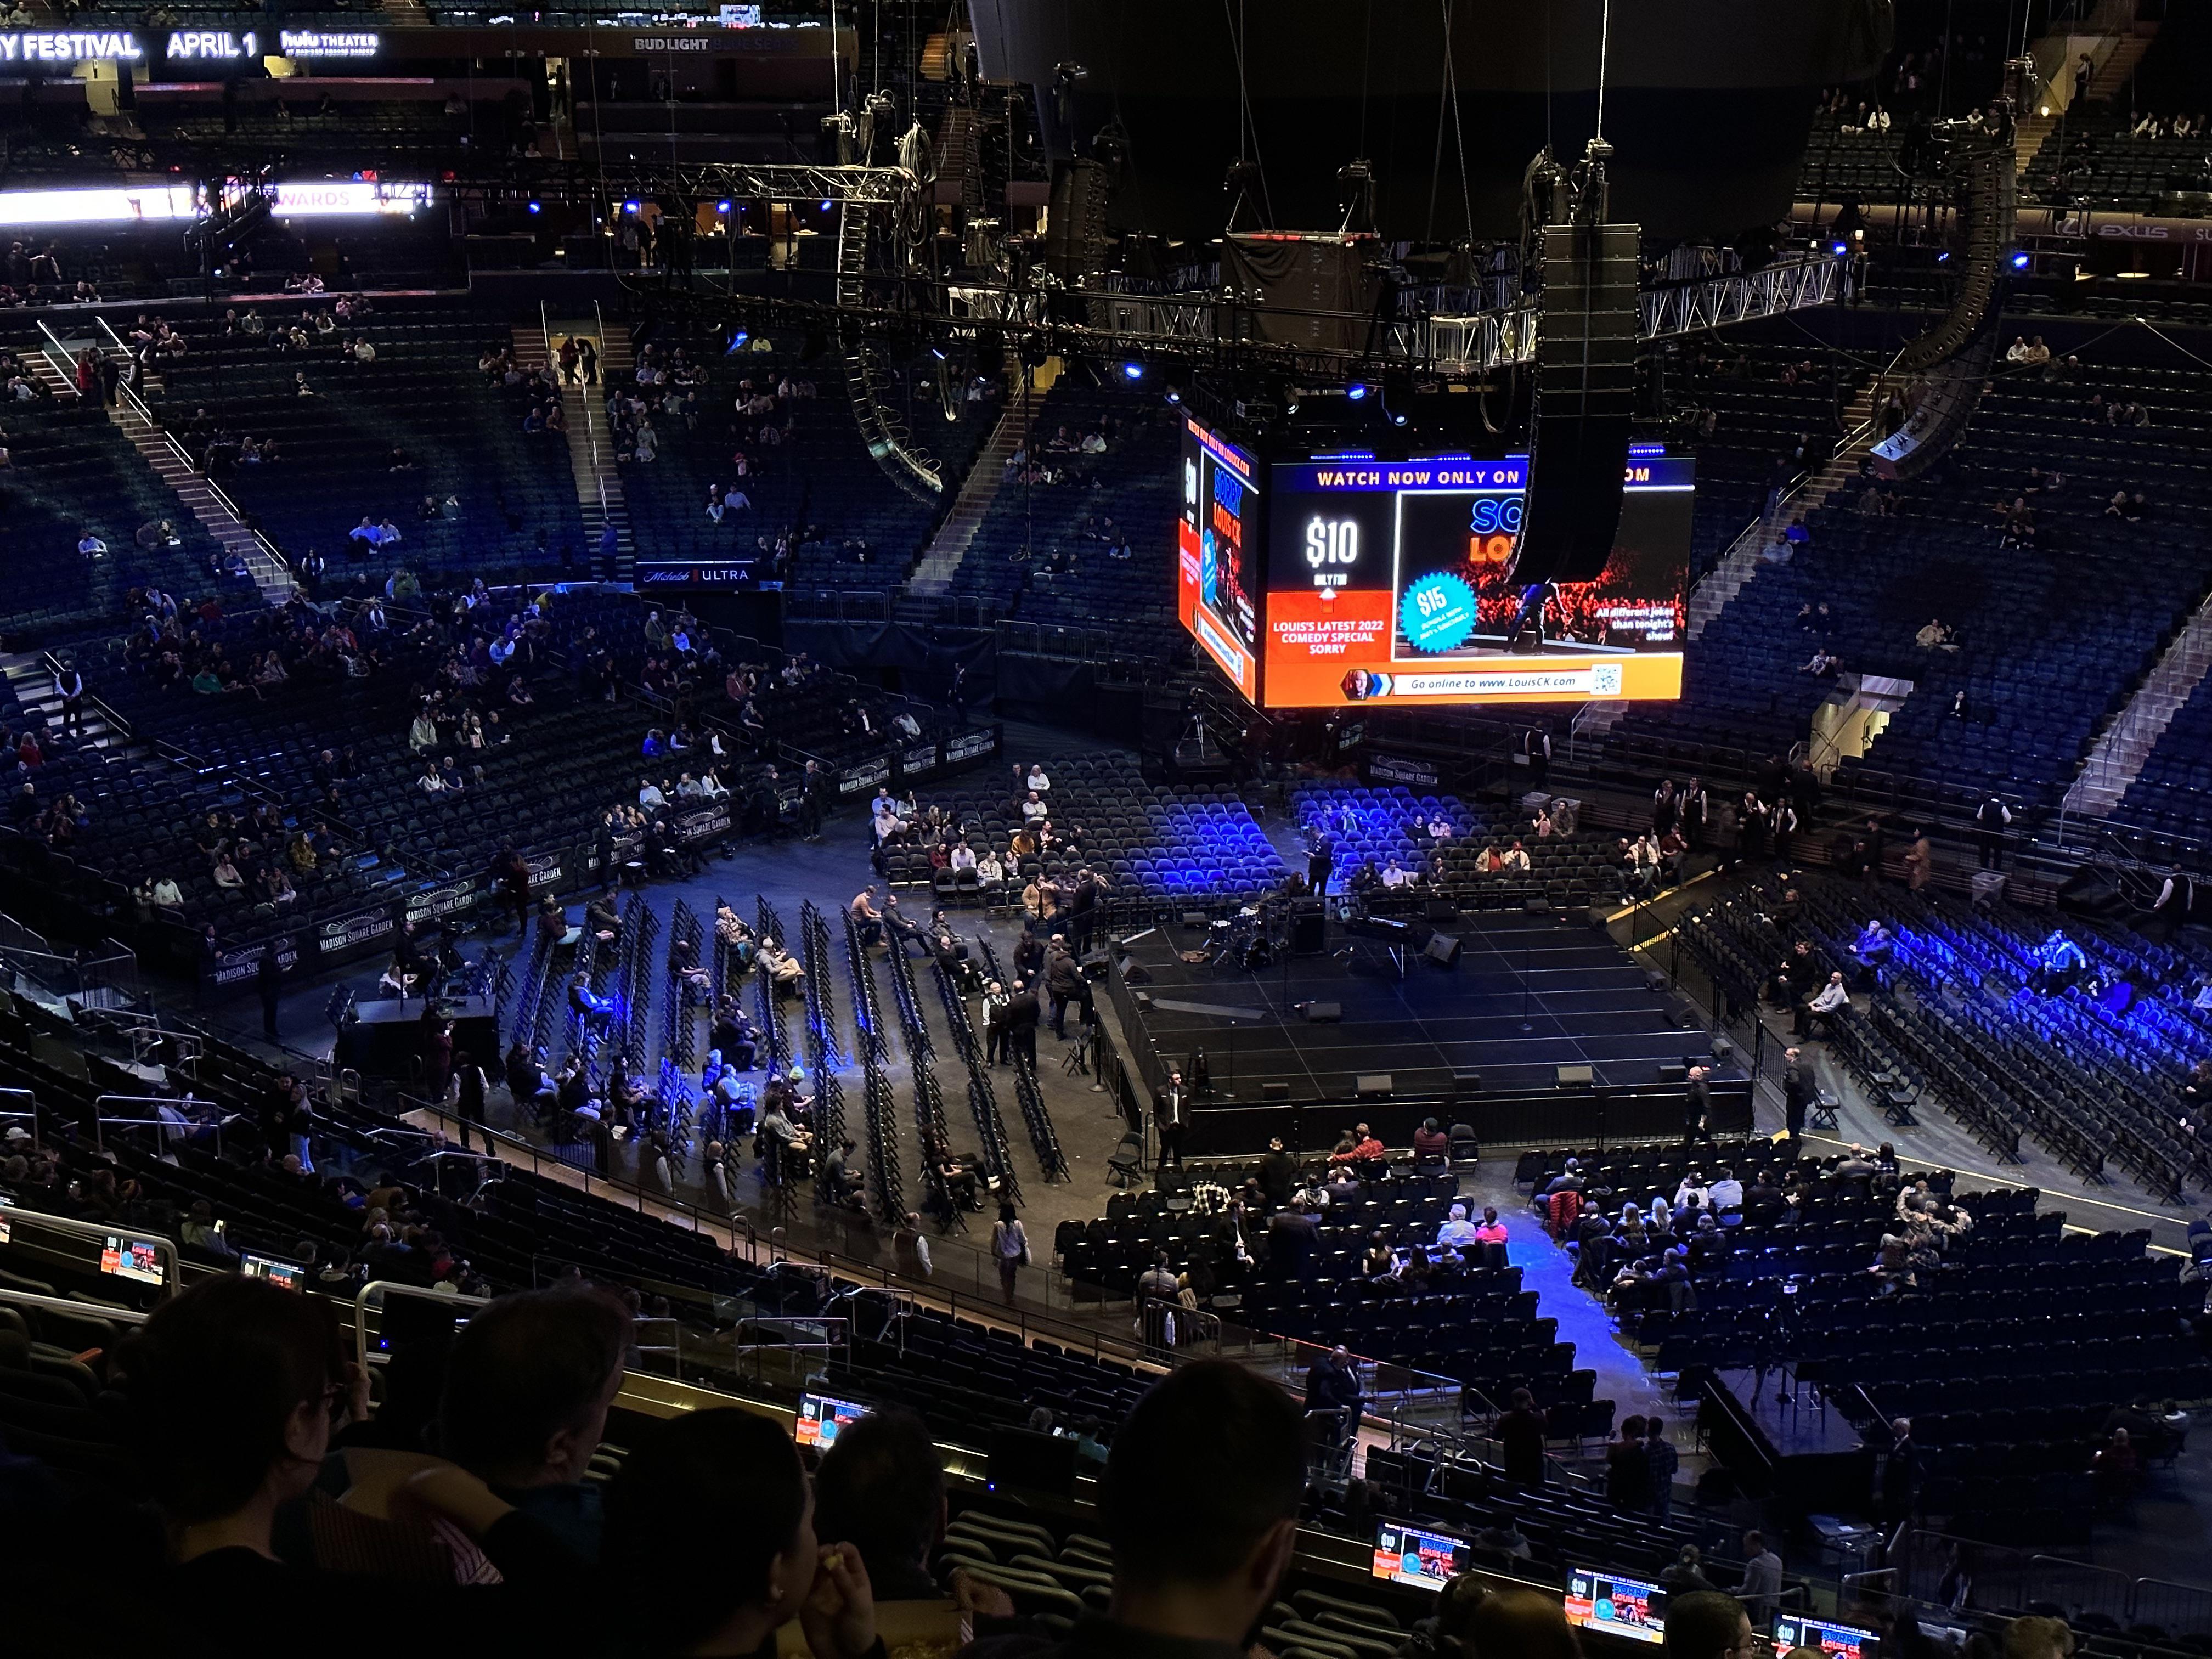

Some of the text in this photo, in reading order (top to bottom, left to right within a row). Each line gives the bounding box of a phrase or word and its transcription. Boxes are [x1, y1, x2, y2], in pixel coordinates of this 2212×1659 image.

[22, 32, 142, 60] FESTIVAL
[167, 32, 256, 58] APRIL 1
[280, 30, 378, 48] hulu THEATER
[635, 38, 708, 50] BUD LIGHT
[278, 191, 349, 207] WARDS
[1317, 471, 1380, 486] WATCH
[1388, 471, 1431, 485] NOW
[1438, 470, 1486, 485] ONLY
[1493, 470, 1519, 484] ON
[1214, 467, 1243, 518] SORRY
[1214, 501, 1232, 538] LOUIS
[1232, 519, 1242, 548] CK
[1307, 516, 1357, 568] $10
[644, 570, 748, 582] Michelob ULTRA
[1417, 585, 1448, 617] $15
[1596, 607, 1675, 618] All different jokes
[1273, 620, 1384, 632] LOUIS'S LATEST 2022
[1612, 619, 1674, 630] than tonight's
[1281, 632, 1375, 644] COMEDY SPECIAL
[1310, 644, 1346, 654] SORRY
[1412, 677, 1576, 689] Go online to www.LouisCK.com
[1370, 765, 1394, 779] MADISON
[1395, 769, 1416, 782] SQUARE
[693, 822, 711, 835] SQUARE
[712, 816, 731, 830] GARDEN
[528, 873, 538, 884] ARE
[539, 867, 561, 881] GARDEN
[406, 906, 431, 921] MADISON
[432, 899, 454, 915] SQUARE
[320, 934, 346, 951] MADISON
[347, 926, 370, 942] SQUARE
[370, 919, 393, 934] GARDEN
[216, 965, 245, 983] MADISON
[247, 961, 259, 973] SQU
[278, 950, 298, 964] ARDEN
[1380, 1532, 1395, 1548] $10
[1419, 1538, 1455, 1554] SORRY
[1419, 1547, 1453, 1561] LOUIS CK
[1571, 1578, 1587, 1594] $10
[1612, 1583, 1649, 1599] SORRY
[1612, 1593, 1635, 1604] LOUIS
[1778, 1624, 1795, 1641] $10
[1821, 1630, 1861, 1645] SORRY
[1821, 1639, 1860, 1654] LOUIS CK
